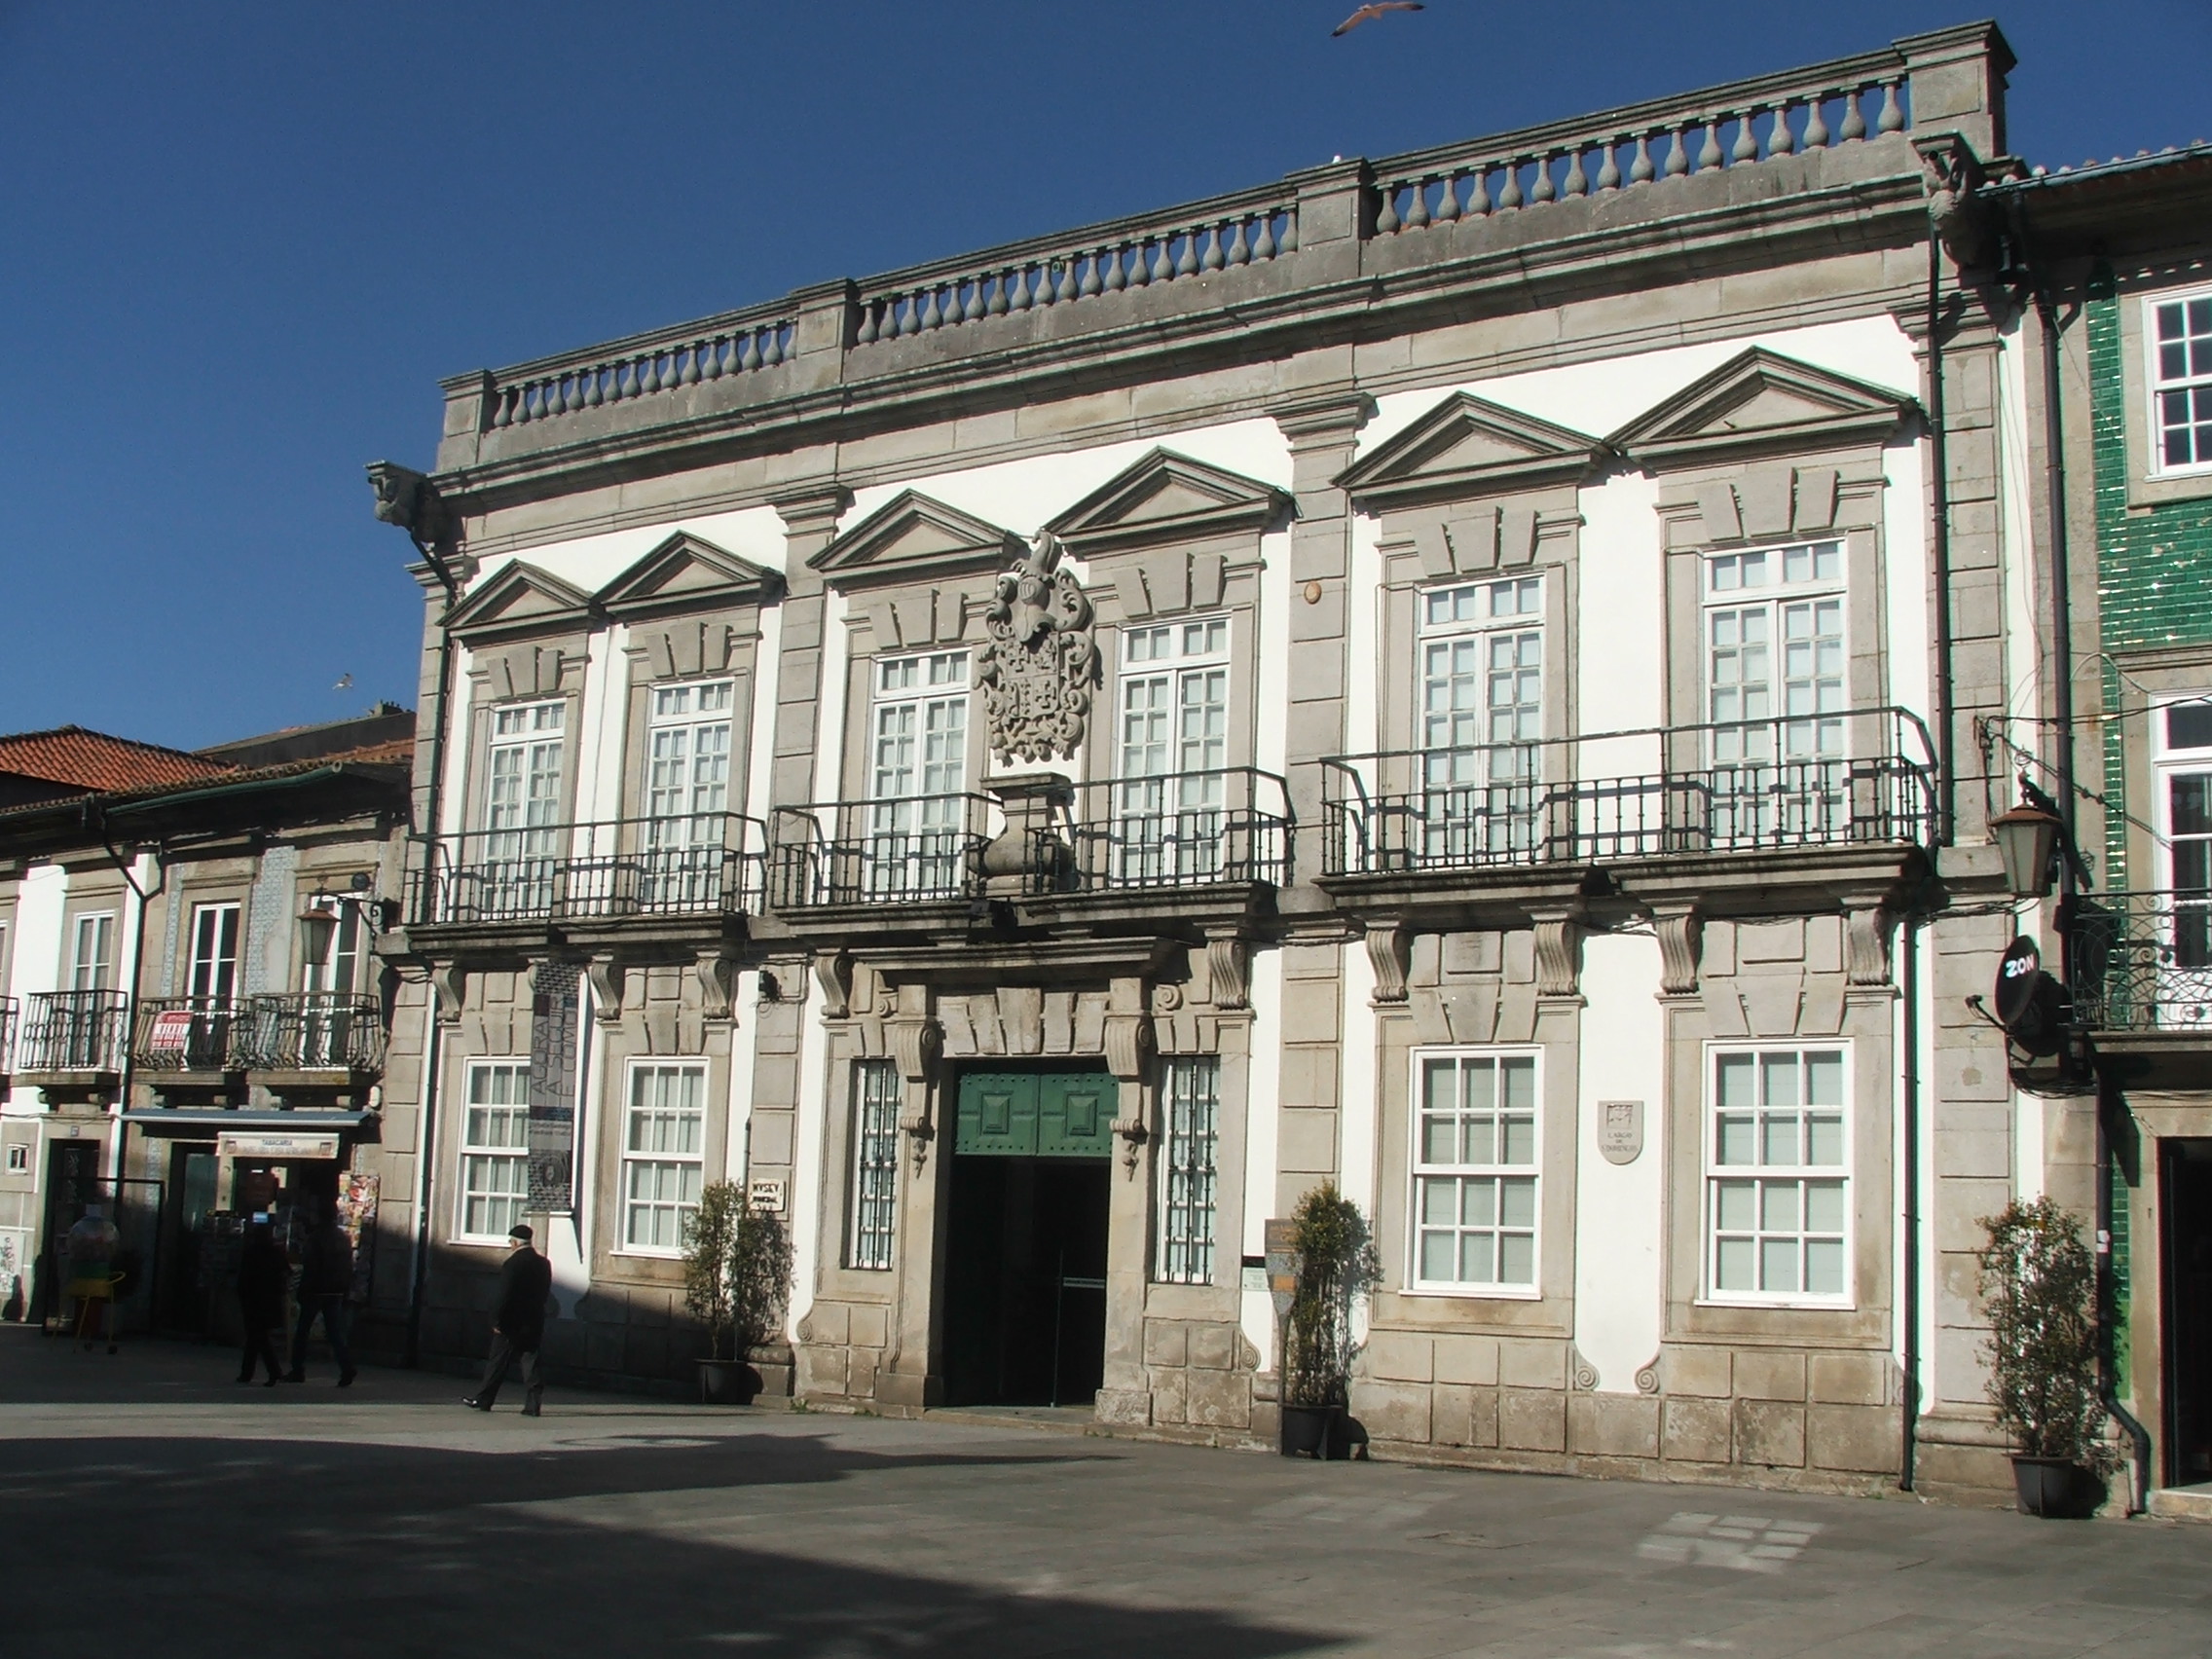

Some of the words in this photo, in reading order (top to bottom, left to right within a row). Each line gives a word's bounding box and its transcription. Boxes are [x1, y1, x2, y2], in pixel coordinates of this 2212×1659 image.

[2006, 954, 2035, 977] ZON
[532, 1020, 548, 1094] AGORA
[546, 1080, 561, 1095] A
